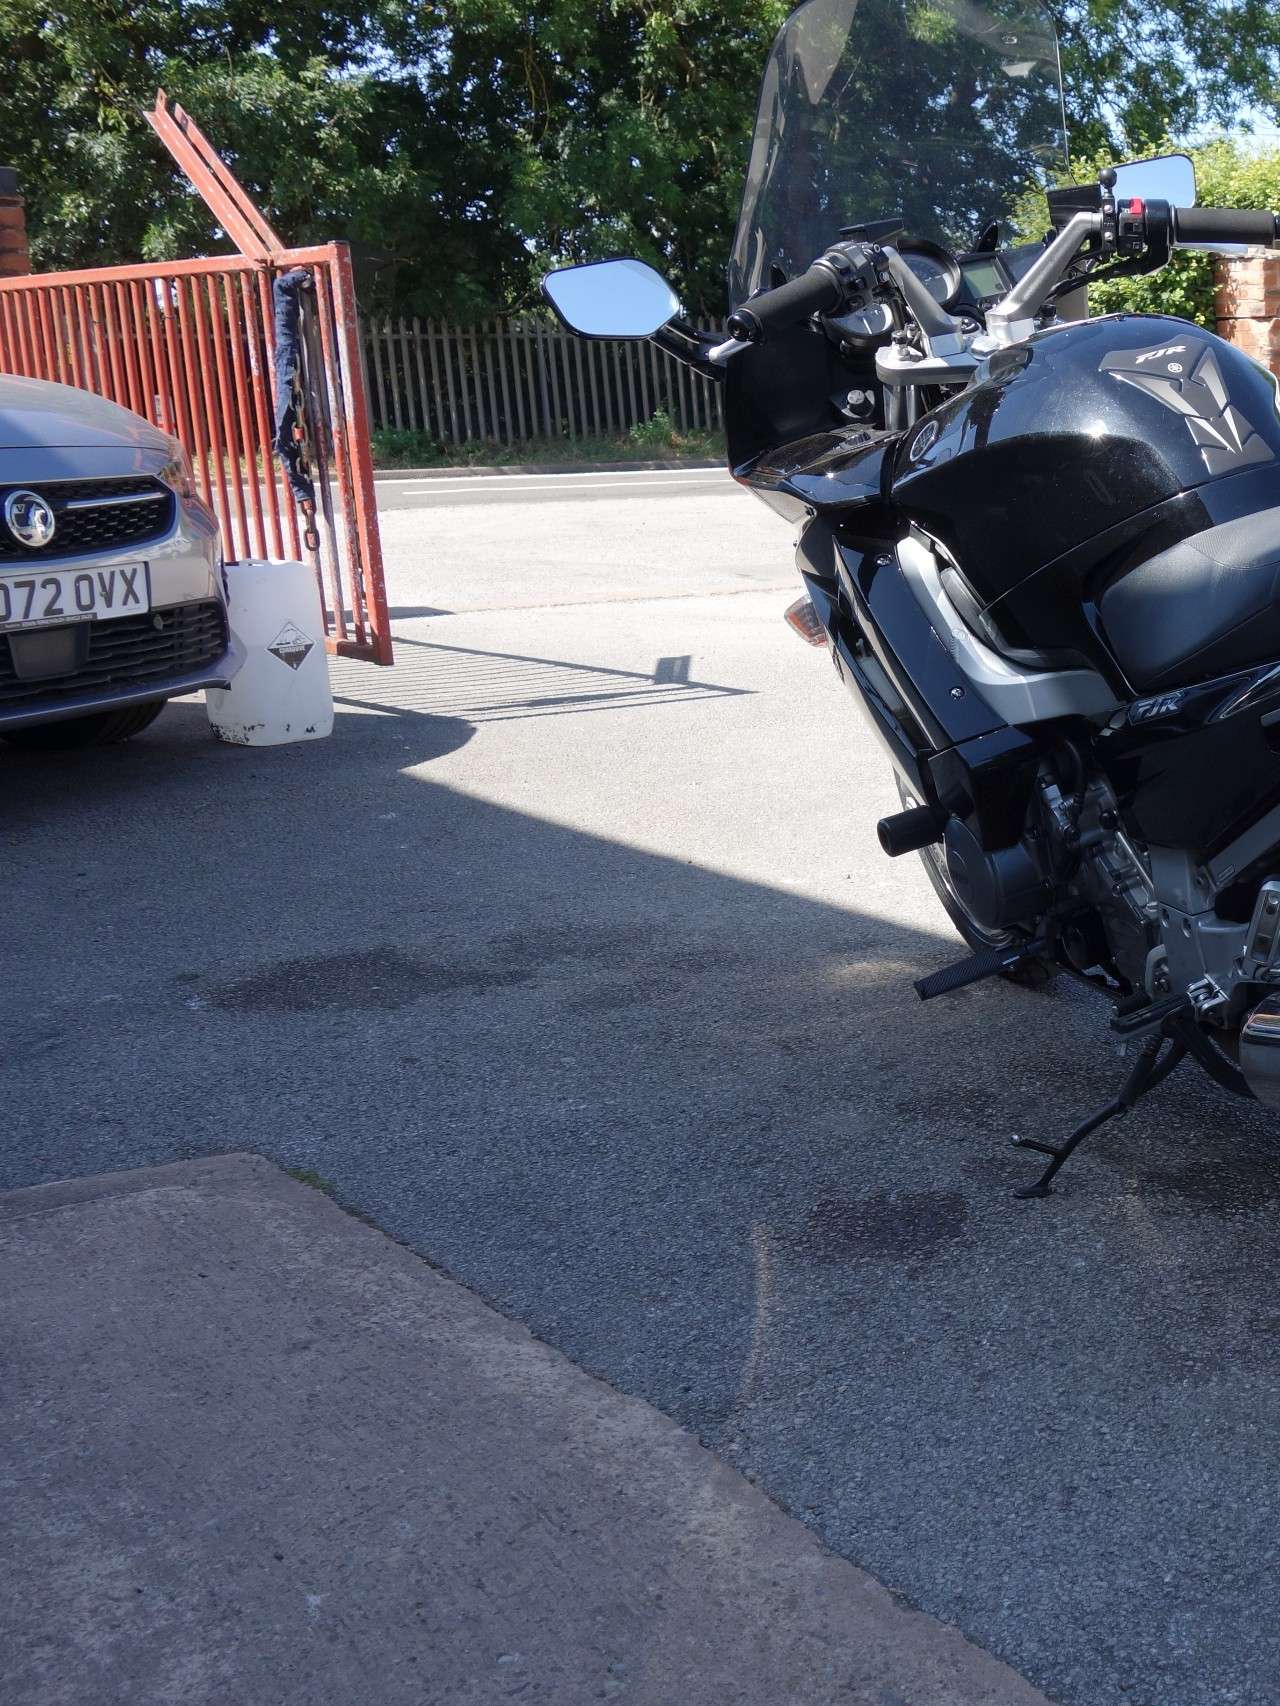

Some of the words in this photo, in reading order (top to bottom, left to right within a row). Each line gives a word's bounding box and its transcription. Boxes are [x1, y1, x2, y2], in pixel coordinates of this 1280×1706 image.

[1135, 345, 1187, 365] FJR
[74, 567, 140, 612] OVX
[1136, 691, 1182, 718] FJR
